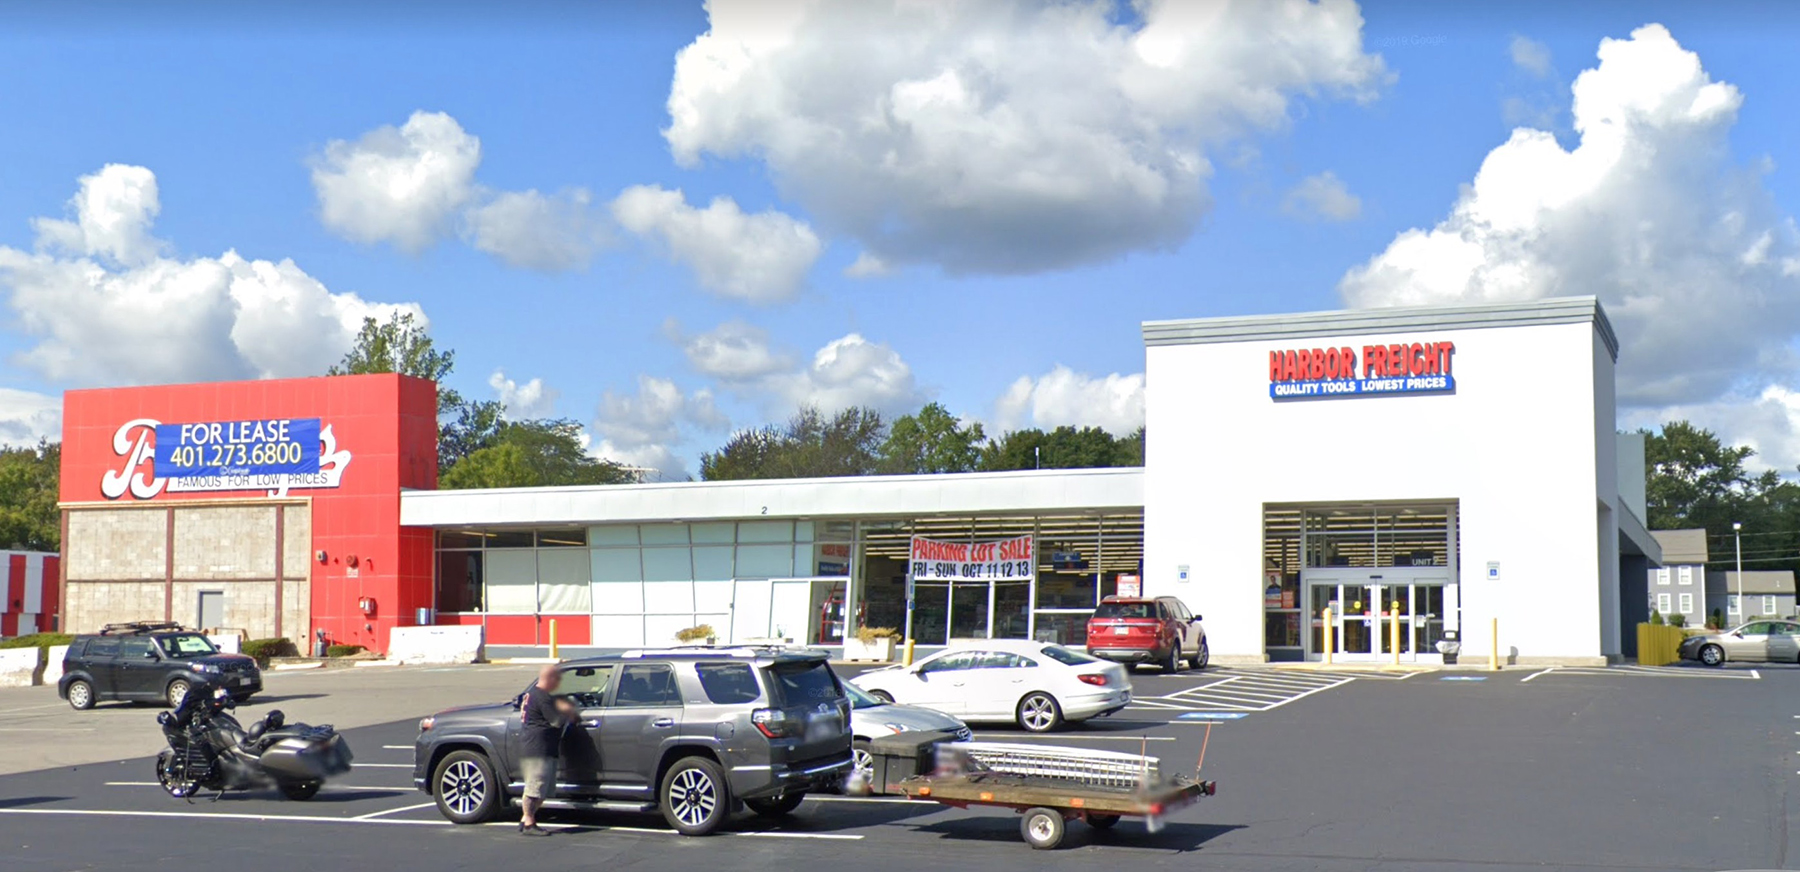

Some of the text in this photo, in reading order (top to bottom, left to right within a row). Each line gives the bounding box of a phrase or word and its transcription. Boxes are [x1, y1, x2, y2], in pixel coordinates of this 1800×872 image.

[1269, 341, 1453, 382] HARBOR FREIGHT
[1275, 377, 1446, 395] QUALITY TOOLS LOWEST PRICES
[181, 420, 290, 445] FOR LEASE
[170, 442, 301, 467] 401.273.6800
[177, 472, 328, 488] FAMOUS FOR LOW PRICES
[761, 505, 768, 515] 2
[912, 536, 1031, 562] PARKING LOT SALE
[962, 564, 983, 578] OCT
[987, 563, 998, 578] 11
[1001, 562, 1013, 577] 12
[1016, 561, 1029, 577] 13
[1412, 558, 1431, 566] UNIT
